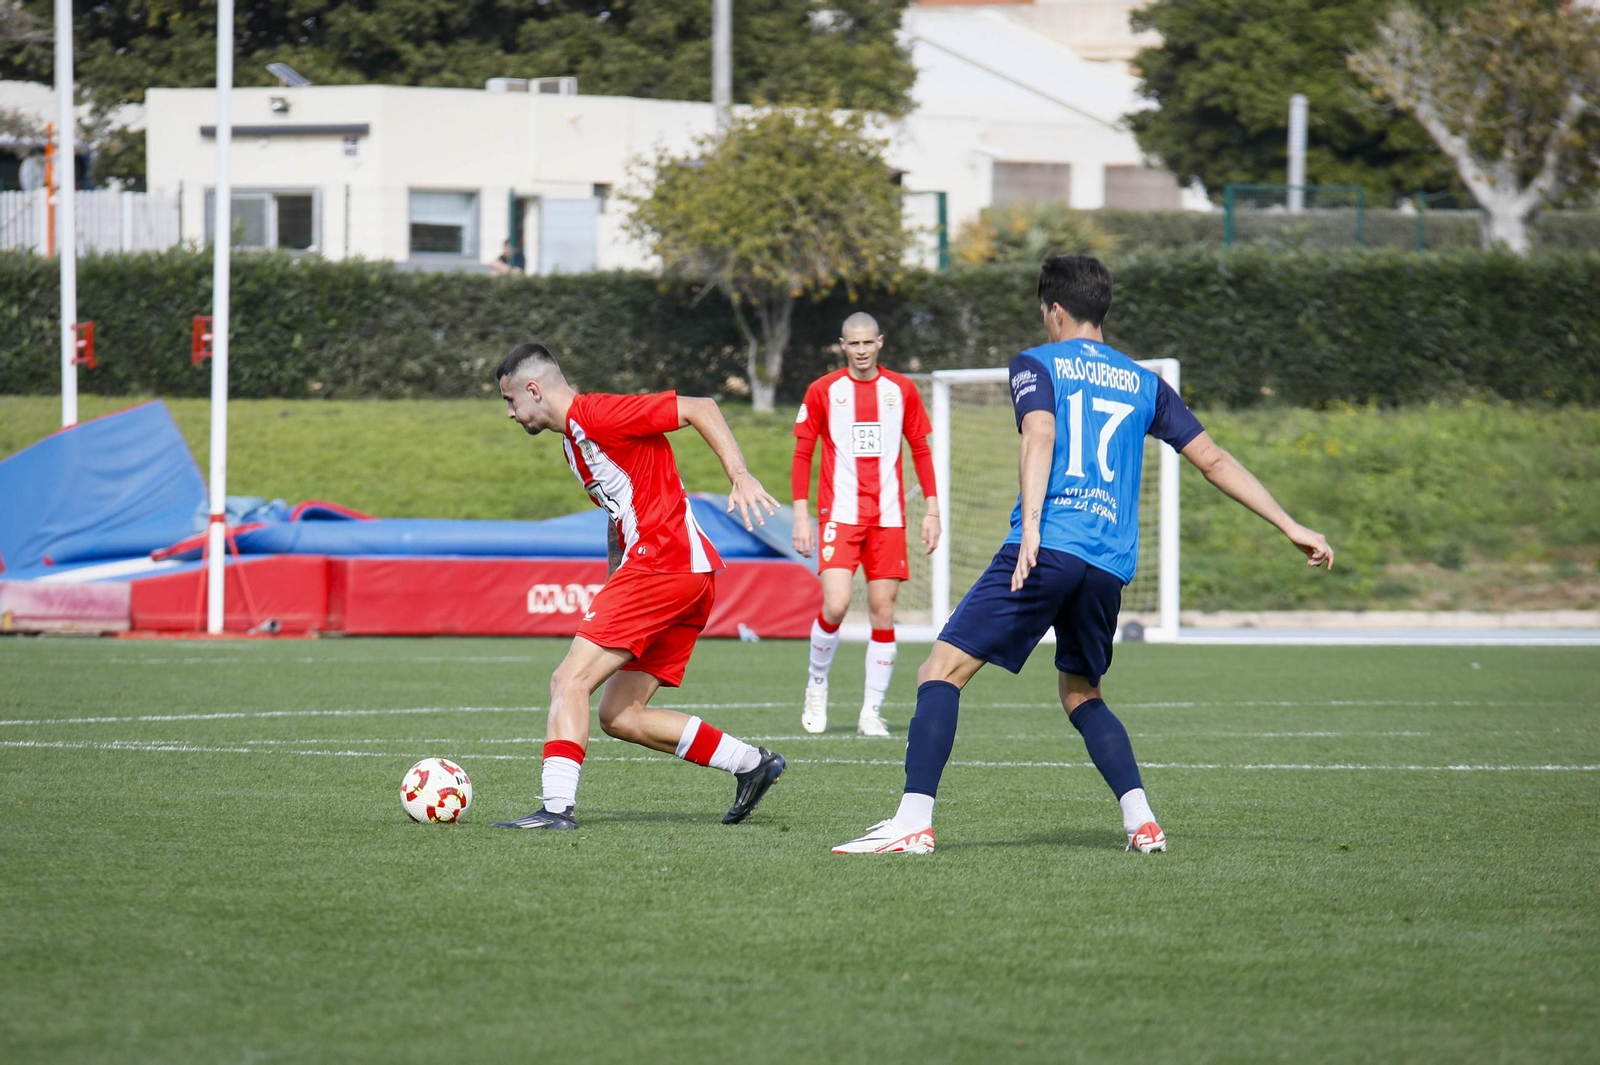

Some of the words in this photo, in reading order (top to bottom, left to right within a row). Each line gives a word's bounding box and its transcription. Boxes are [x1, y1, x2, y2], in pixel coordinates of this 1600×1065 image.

[1054, 357, 1085, 381] PABLO
[1085, 360, 1140, 394] GUERRERO
[1065, 388, 1135, 483] 17
[823, 521, 837, 543] 6
